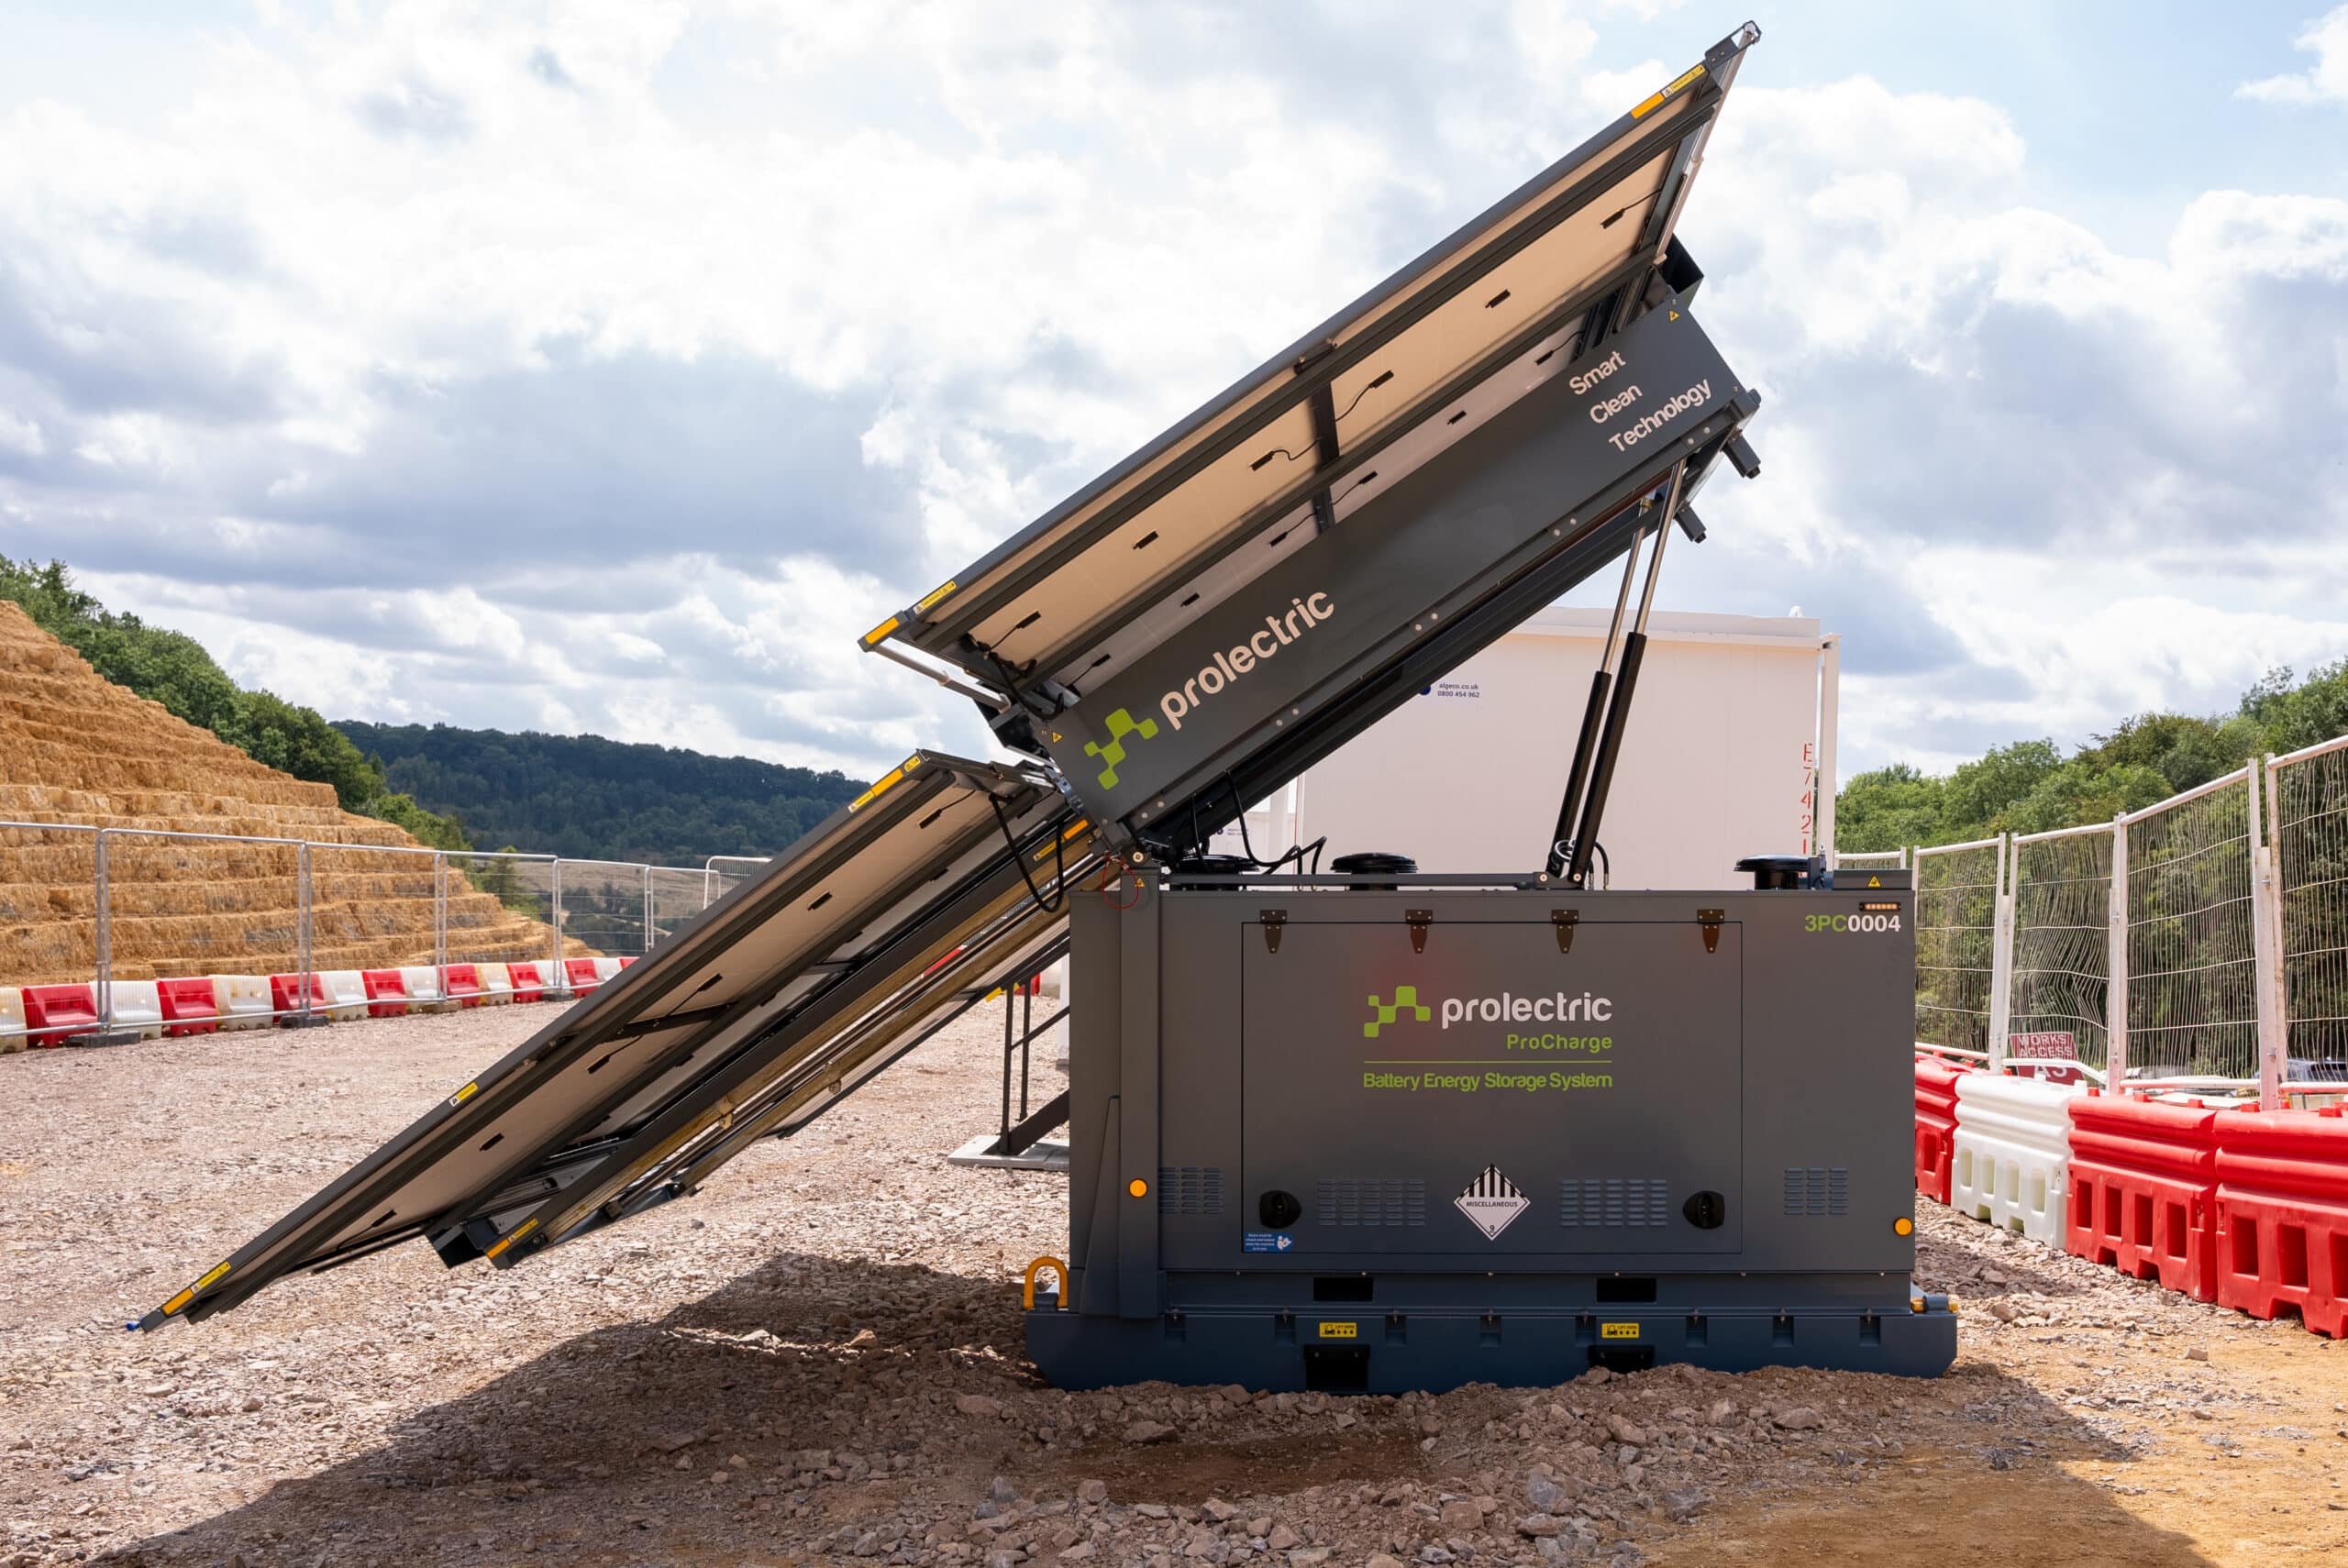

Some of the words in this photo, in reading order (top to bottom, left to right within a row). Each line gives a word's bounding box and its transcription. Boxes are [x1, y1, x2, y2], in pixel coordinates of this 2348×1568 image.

[1569, 350, 1626, 395] Smart
[1589, 384, 1644, 424] Clean
[1609, 379, 1712, 452] Technology
[1159, 591, 1335, 731] prolectric
[1438, 681, 1479, 690] algeco.co.uk
[1804, 914, 1901, 933] 3PC0004
[1441, 992, 1612, 1030] prolectric
[1506, 1033, 1612, 1054] ProCharge
[2018, 1034, 2066, 1046] WORKS
[2020, 1046, 2073, 1057] ACCESS
[1364, 1073, 1421, 1092] Battery
[1423, 1073, 1480, 1092] Energy
[1484, 1072, 1546, 1092] Storage
[1549, 1072, 1612, 1092] System
